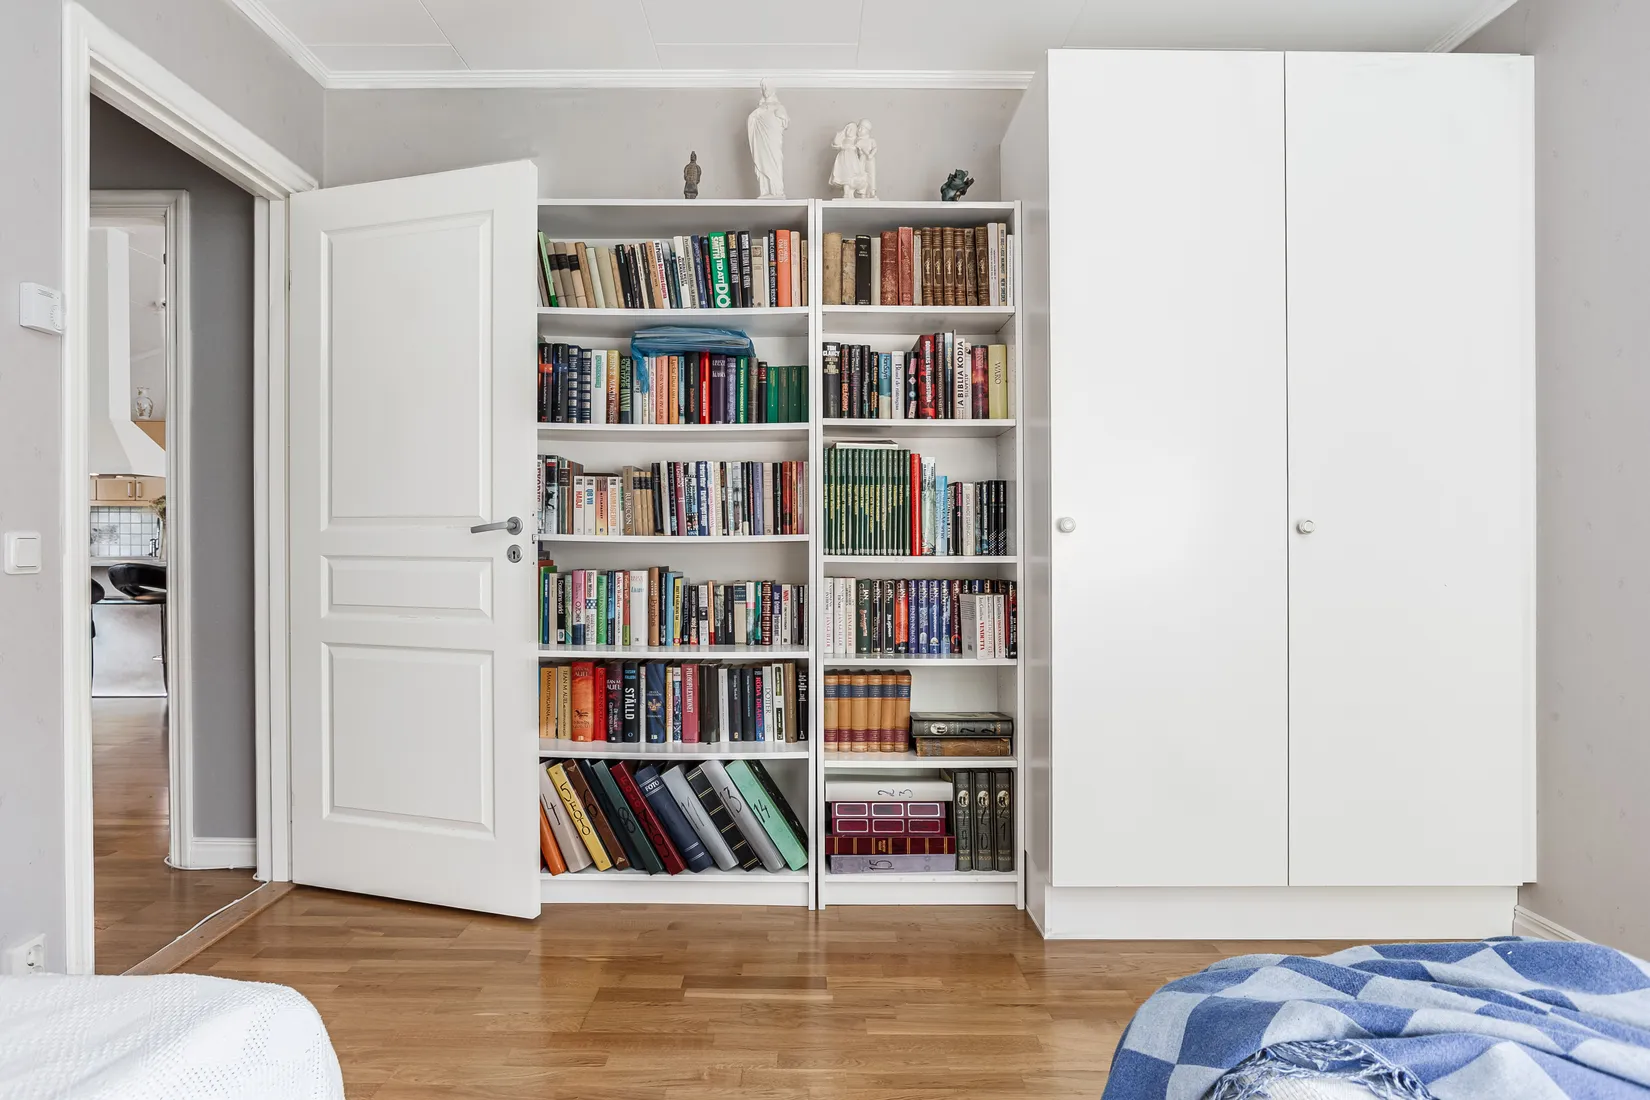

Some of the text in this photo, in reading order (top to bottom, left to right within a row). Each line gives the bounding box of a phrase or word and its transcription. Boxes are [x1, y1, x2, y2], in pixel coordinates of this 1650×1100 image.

[711, 236, 720, 259] SMITH
[778, 239, 784, 248] OM
[716, 270, 724, 283] ATT
[714, 283, 731, 307] DÖ
[608, 378, 616, 400] MAXIM
[586, 489, 594, 497] QB
[650, 599, 658, 627] Pyrrhos
[625, 687, 637, 720] STÄLLD
[645, 780, 660, 792] FOTO
[543, 794, 561, 825] 4
[560, 780, 591, 835] 5 FOTO
[583, 788, 598, 819] 6
[719, 785, 743, 818] 13
[752, 799, 770, 824] 14
[617, 806, 636, 834] 8
[868, 859, 895, 871] 15
